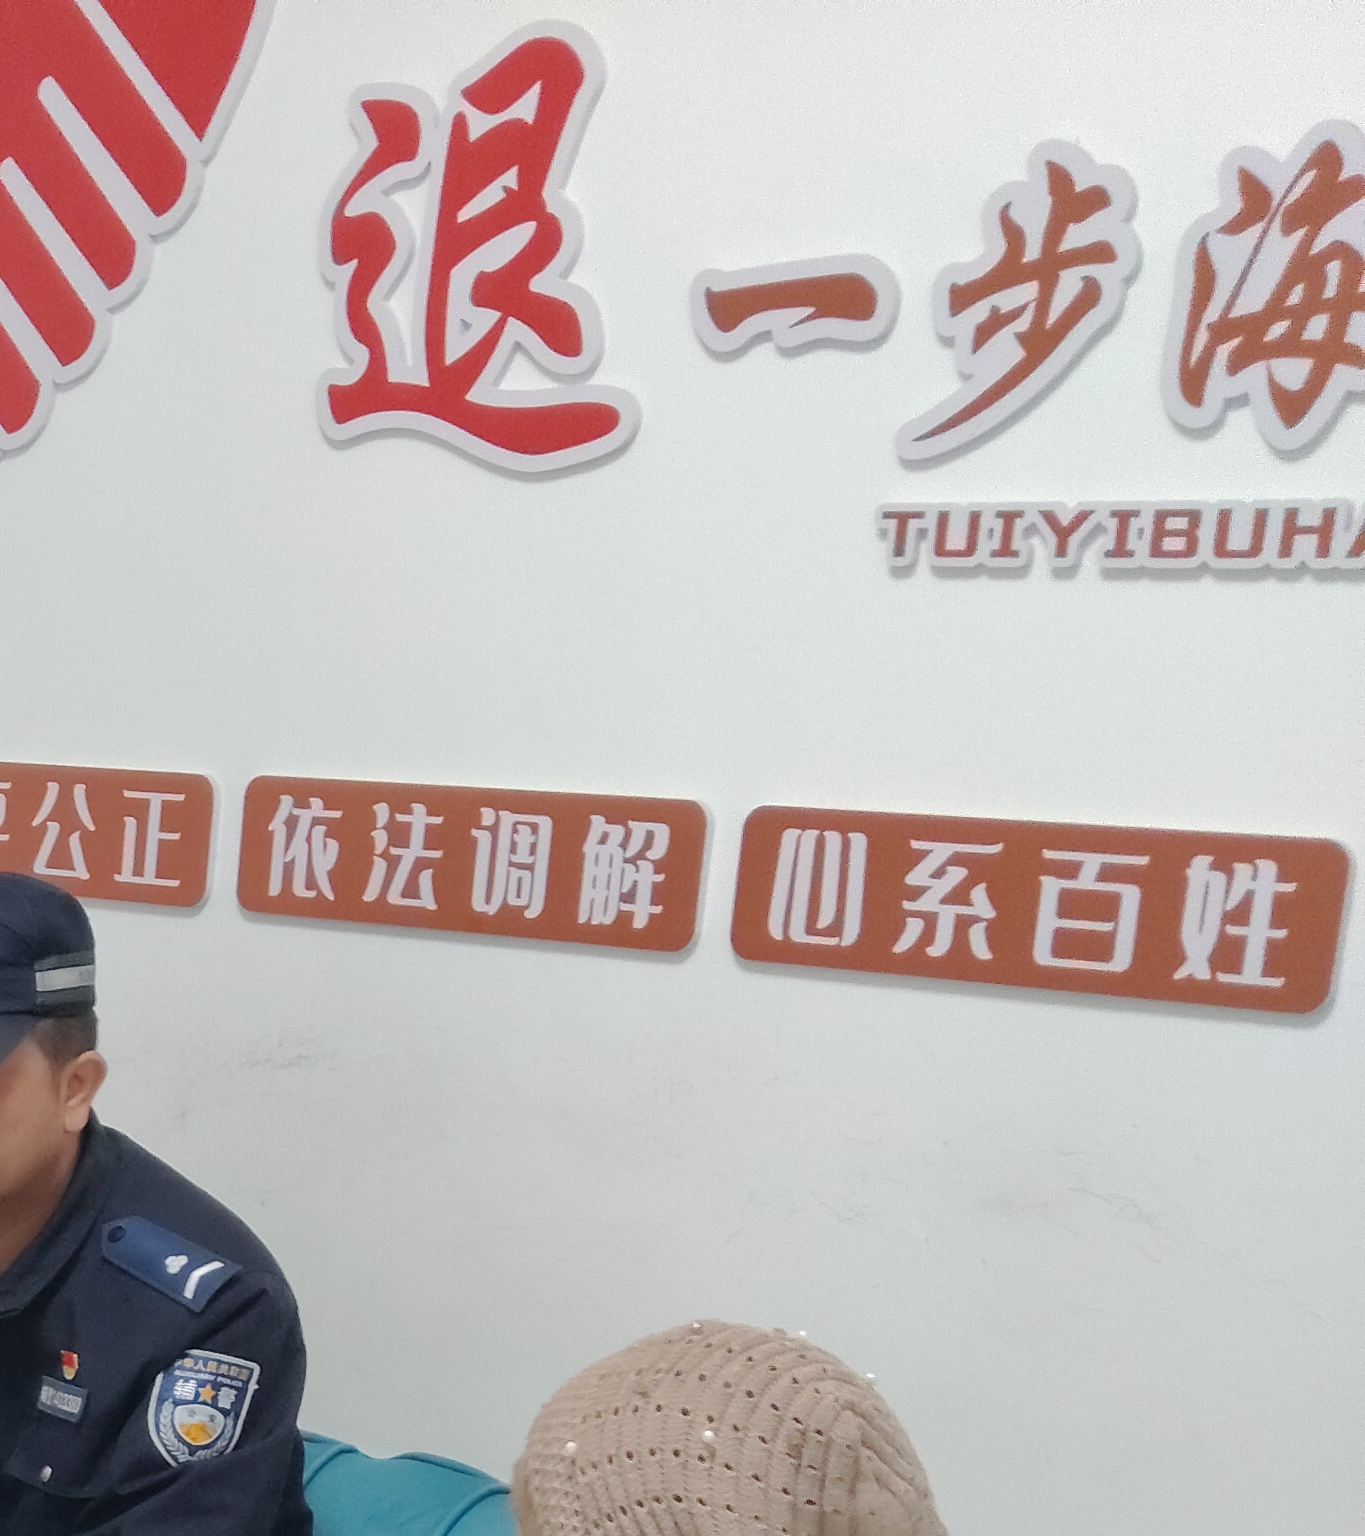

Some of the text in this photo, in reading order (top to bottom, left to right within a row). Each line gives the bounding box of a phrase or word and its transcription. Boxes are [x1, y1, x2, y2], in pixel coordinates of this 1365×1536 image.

[268, 795, 670, 926] 依法调解
[768, 828, 1297, 987] 心系百姓
